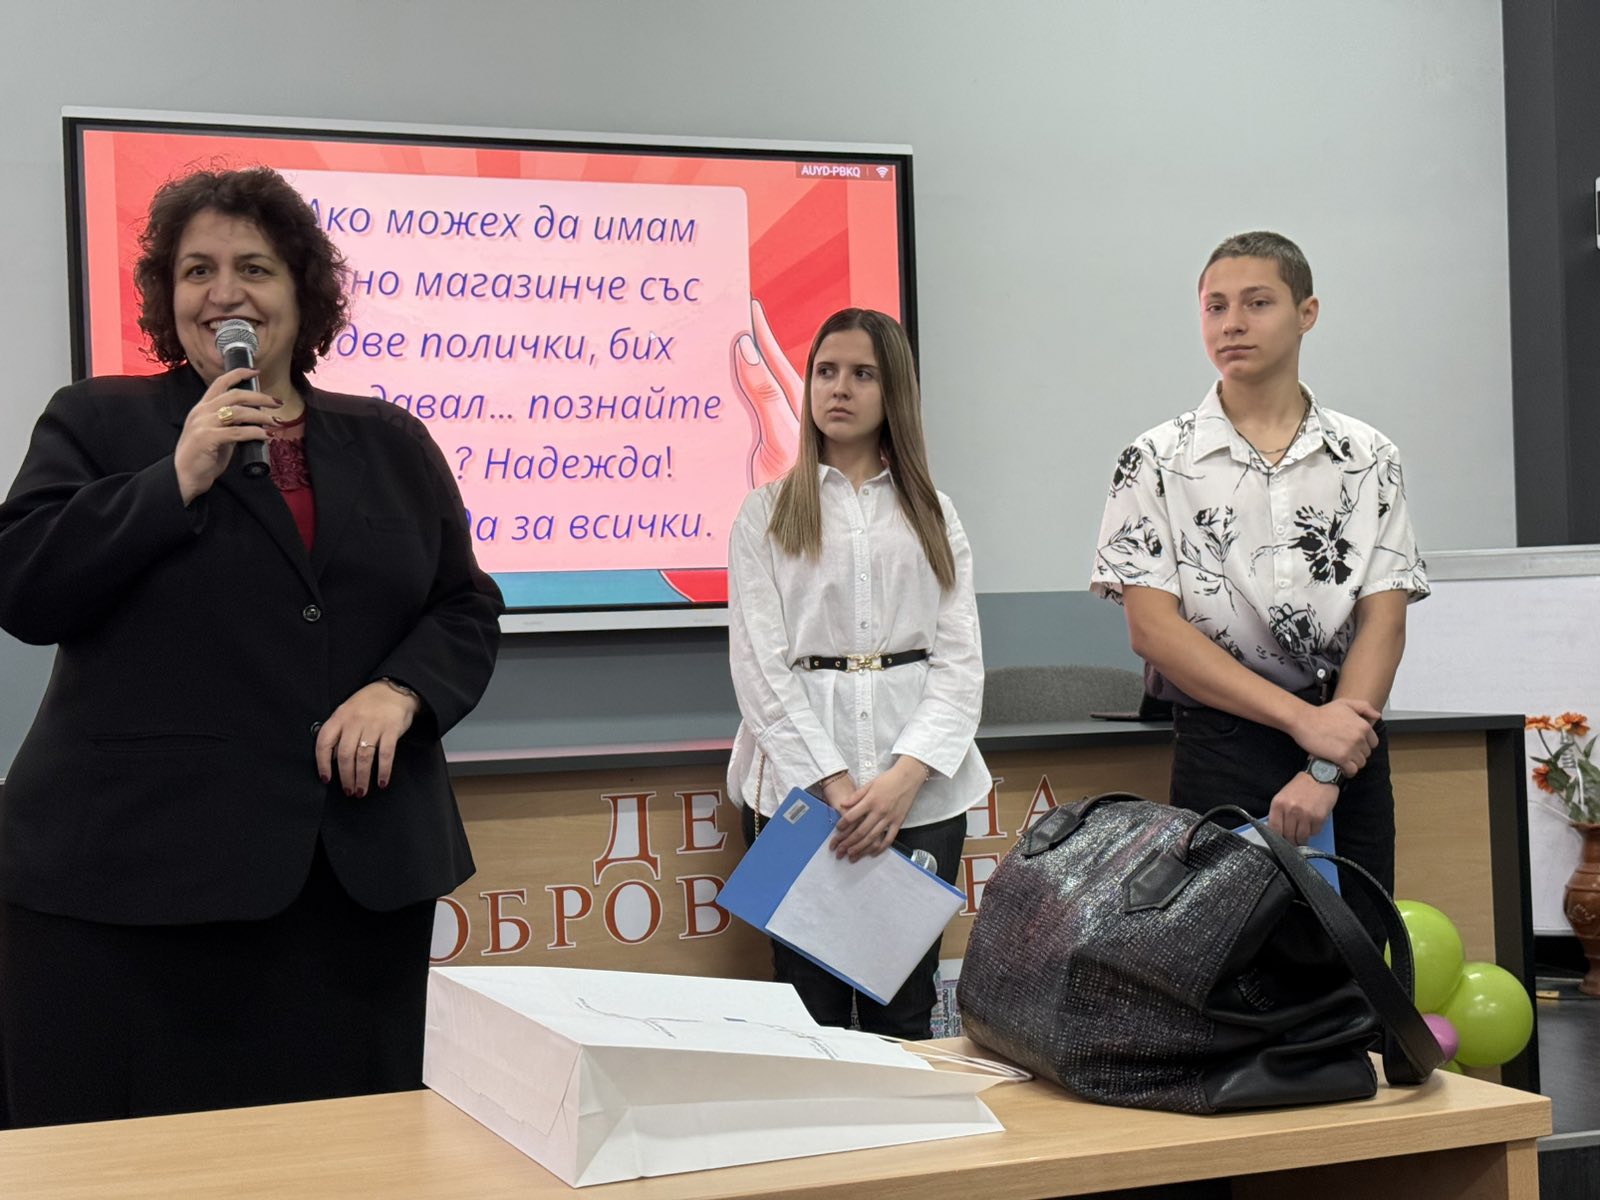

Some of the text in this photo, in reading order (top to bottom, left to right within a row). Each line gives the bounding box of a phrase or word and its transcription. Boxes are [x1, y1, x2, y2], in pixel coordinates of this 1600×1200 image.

[386, 208, 520, 238] можех
[533, 204, 579, 239] да
[593, 215, 696, 243] имам
[340, 269, 700, 302] но магазинче със
[336, 323, 675, 366] две полички, бих
[528, 386, 721, 420] познайте
[484, 445, 674, 480] Надежда!
[511, 515, 555, 541] за
[569, 512, 712, 541] всички.
